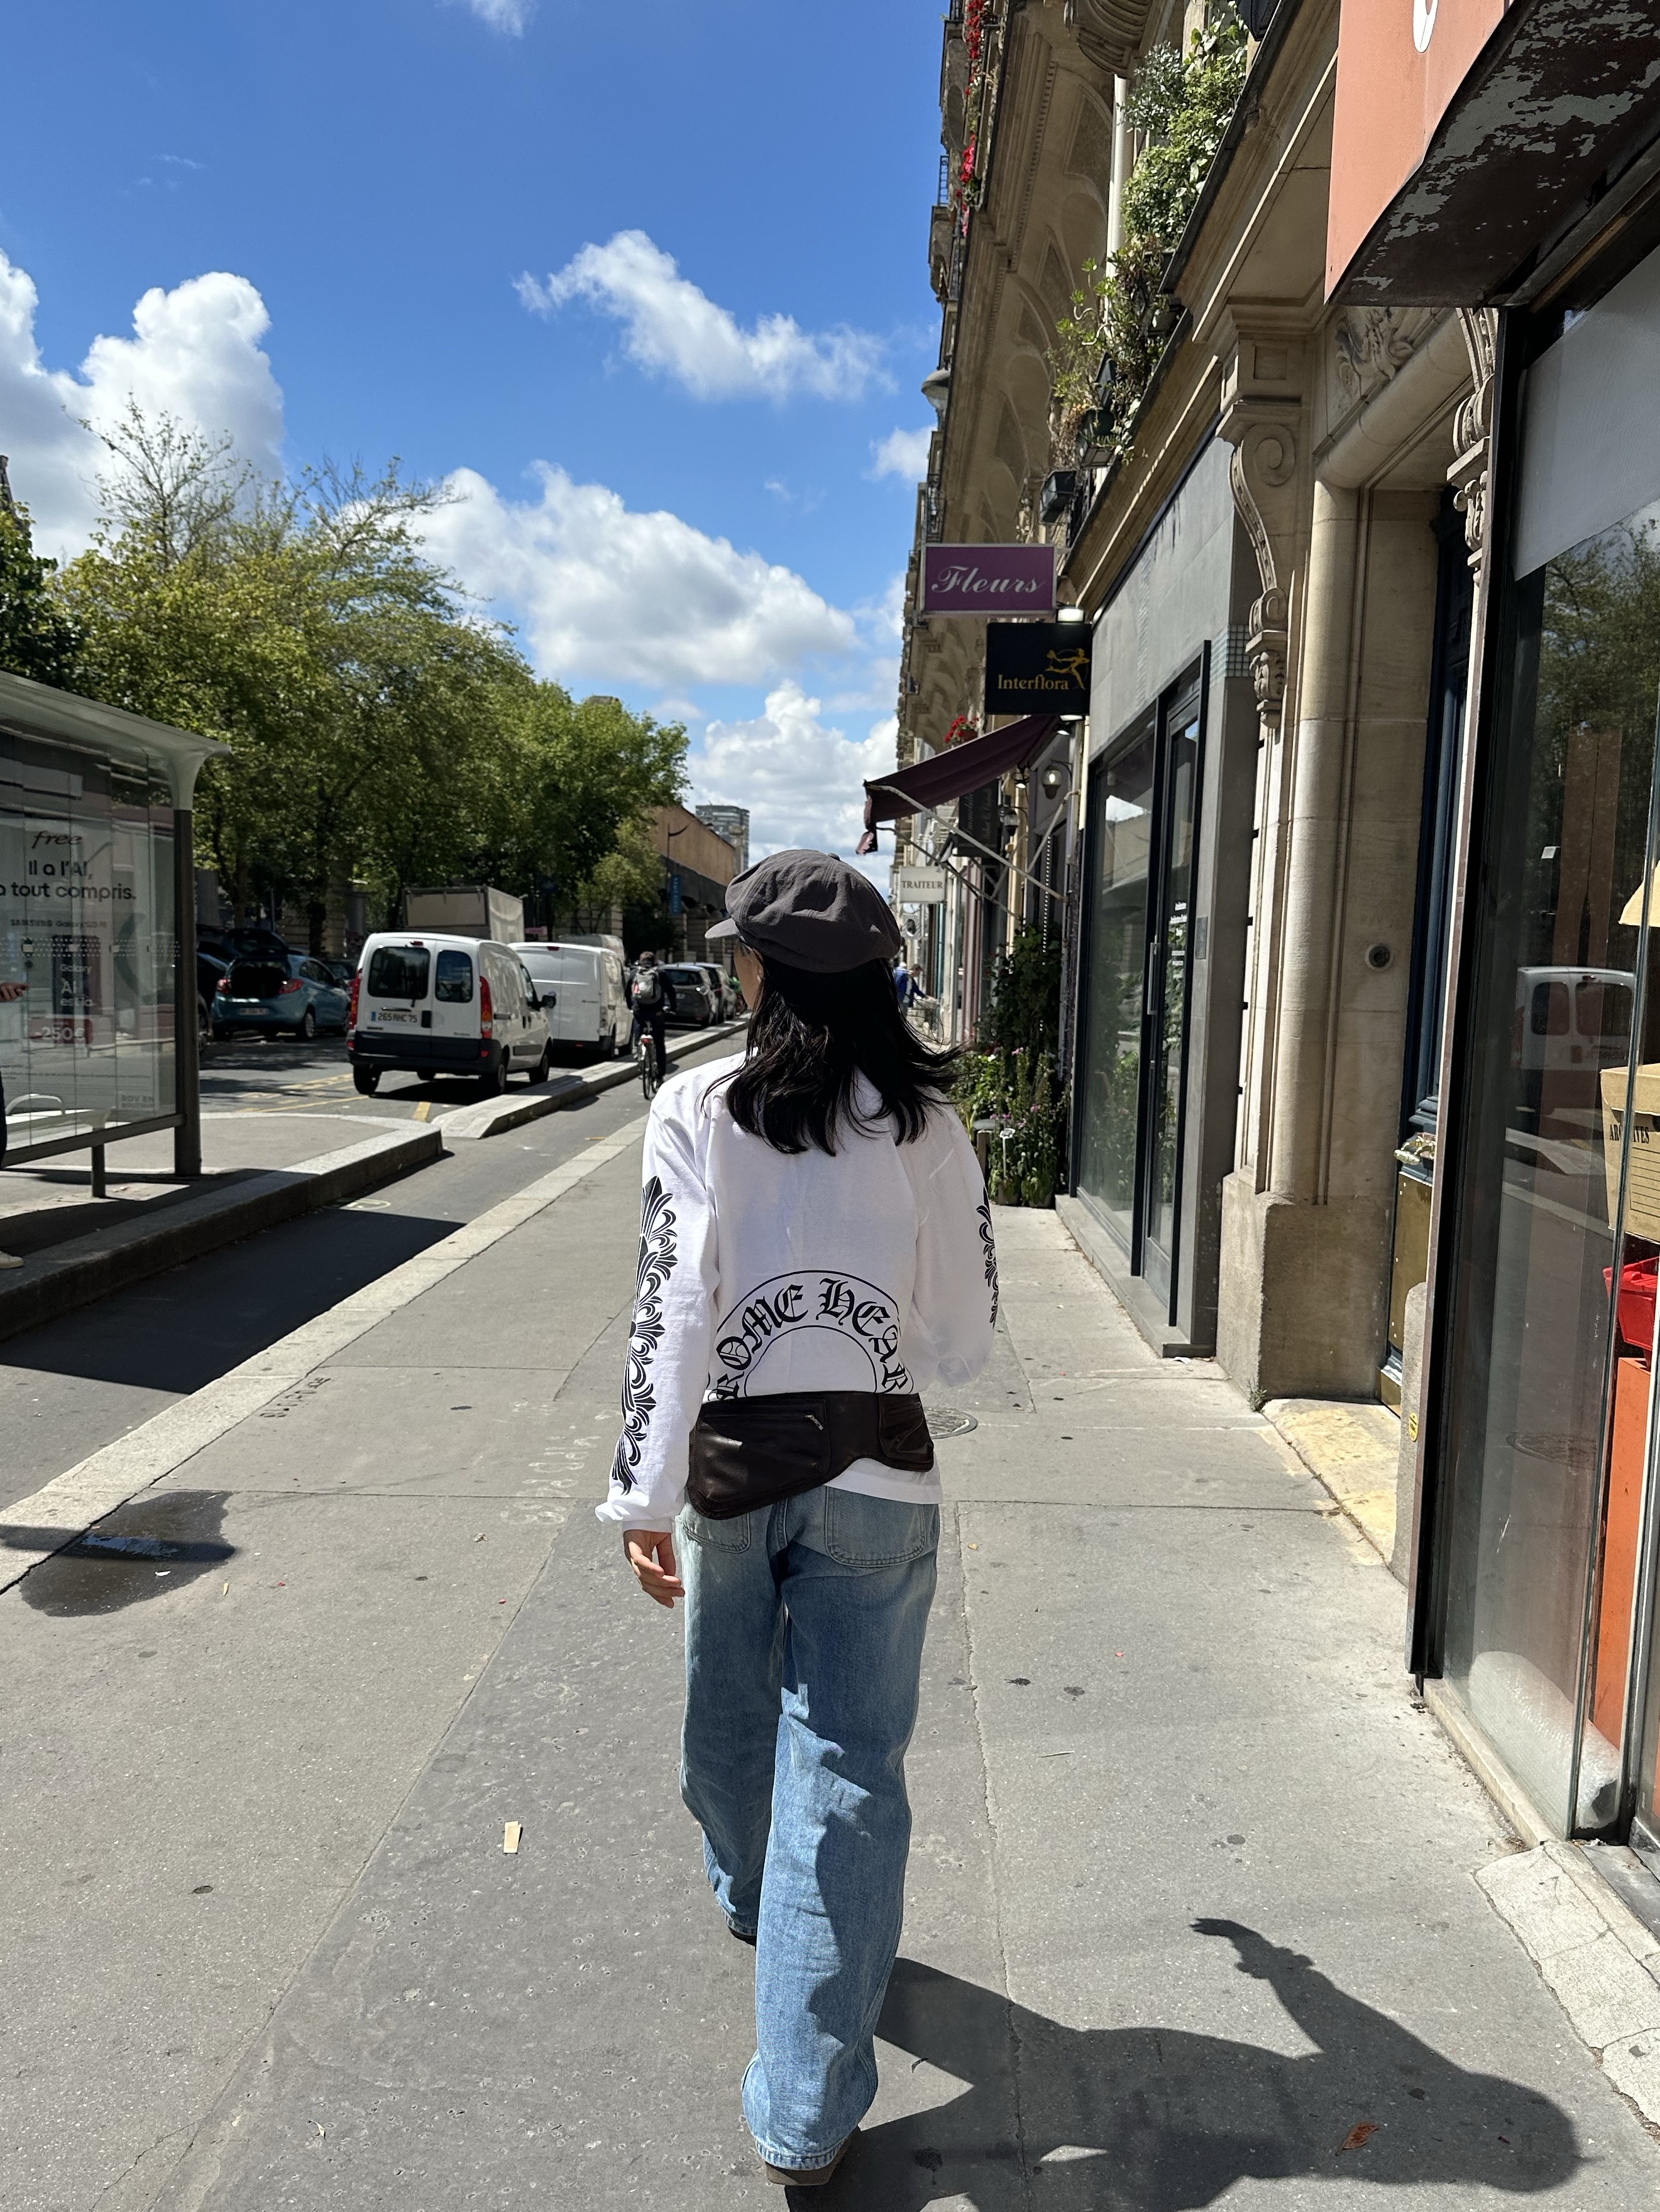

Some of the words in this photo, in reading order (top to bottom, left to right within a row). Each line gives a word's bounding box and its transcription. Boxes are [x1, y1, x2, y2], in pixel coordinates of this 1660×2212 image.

[931, 566, 1044, 593] Fleurs
[998, 674, 1069, 690] Interflora
[32, 830, 83, 849] free
[43, 863, 55, 875] a
[11, 882, 50, 897] tout
[55, 883, 136, 902] compris.
[902, 880, 943, 890] TRAITEUR
[1609, 1124, 1649, 1144] ARIVES
